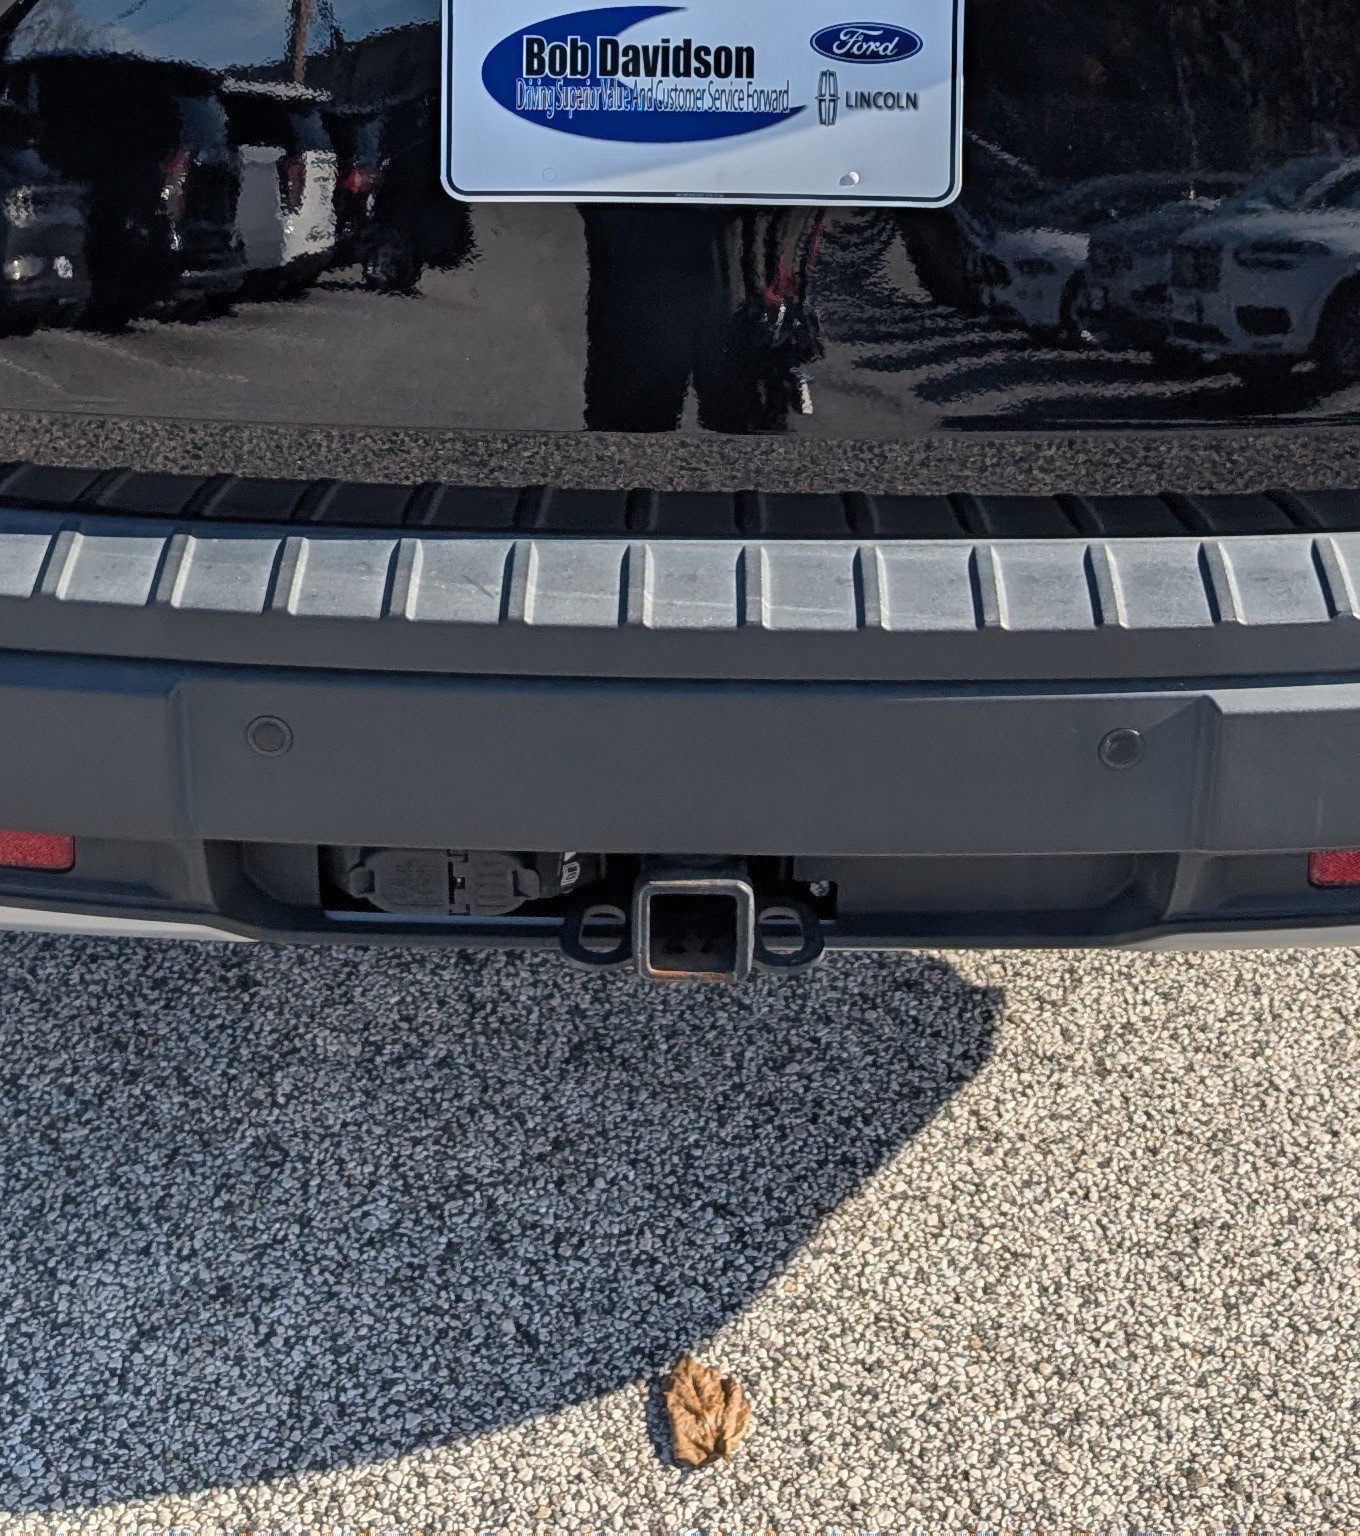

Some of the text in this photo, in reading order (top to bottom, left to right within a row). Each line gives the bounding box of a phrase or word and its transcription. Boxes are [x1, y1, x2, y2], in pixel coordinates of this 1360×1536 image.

[523, 35, 755, 79] Bob Davidson
[832, 27, 900, 56] Ford
[516, 78, 790, 119] Driving Superior Value And Customer Service Forward
[845, 91, 919, 110] LINCOLN
